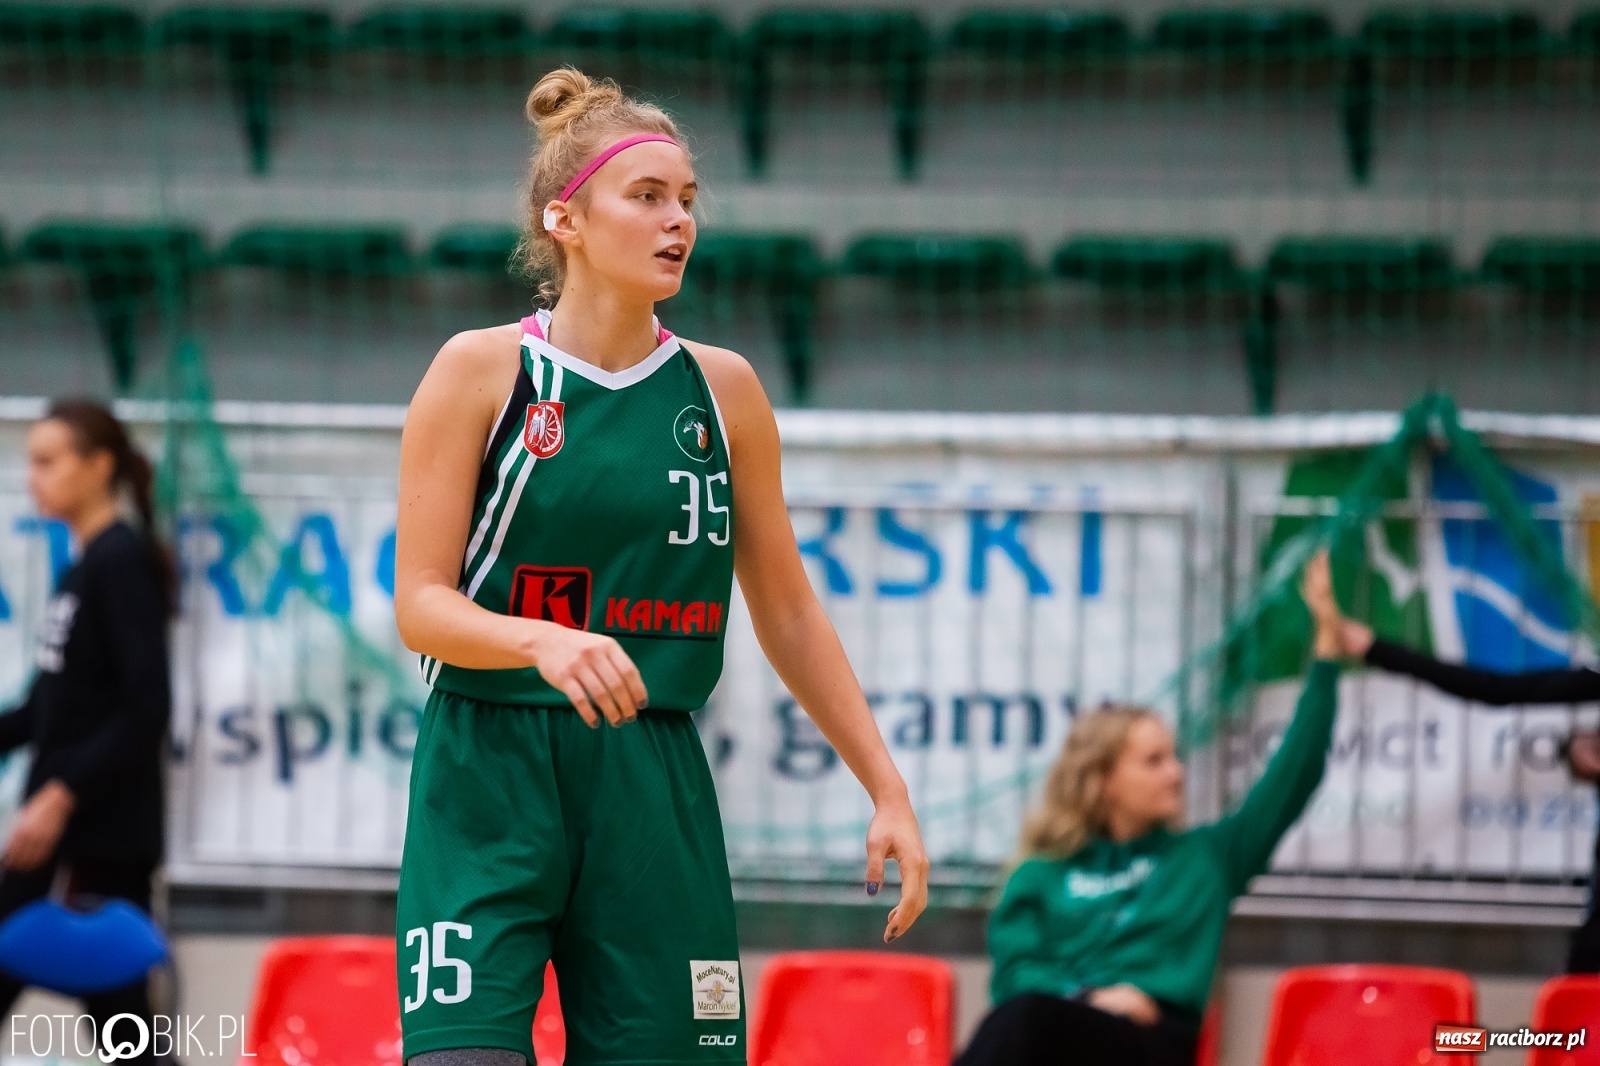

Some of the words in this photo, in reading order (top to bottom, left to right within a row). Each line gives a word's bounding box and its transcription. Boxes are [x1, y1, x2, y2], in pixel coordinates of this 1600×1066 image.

[668, 470, 730, 546] 35
[605, 597, 723, 635] KAMAN
[404, 921, 473, 1013] 35
